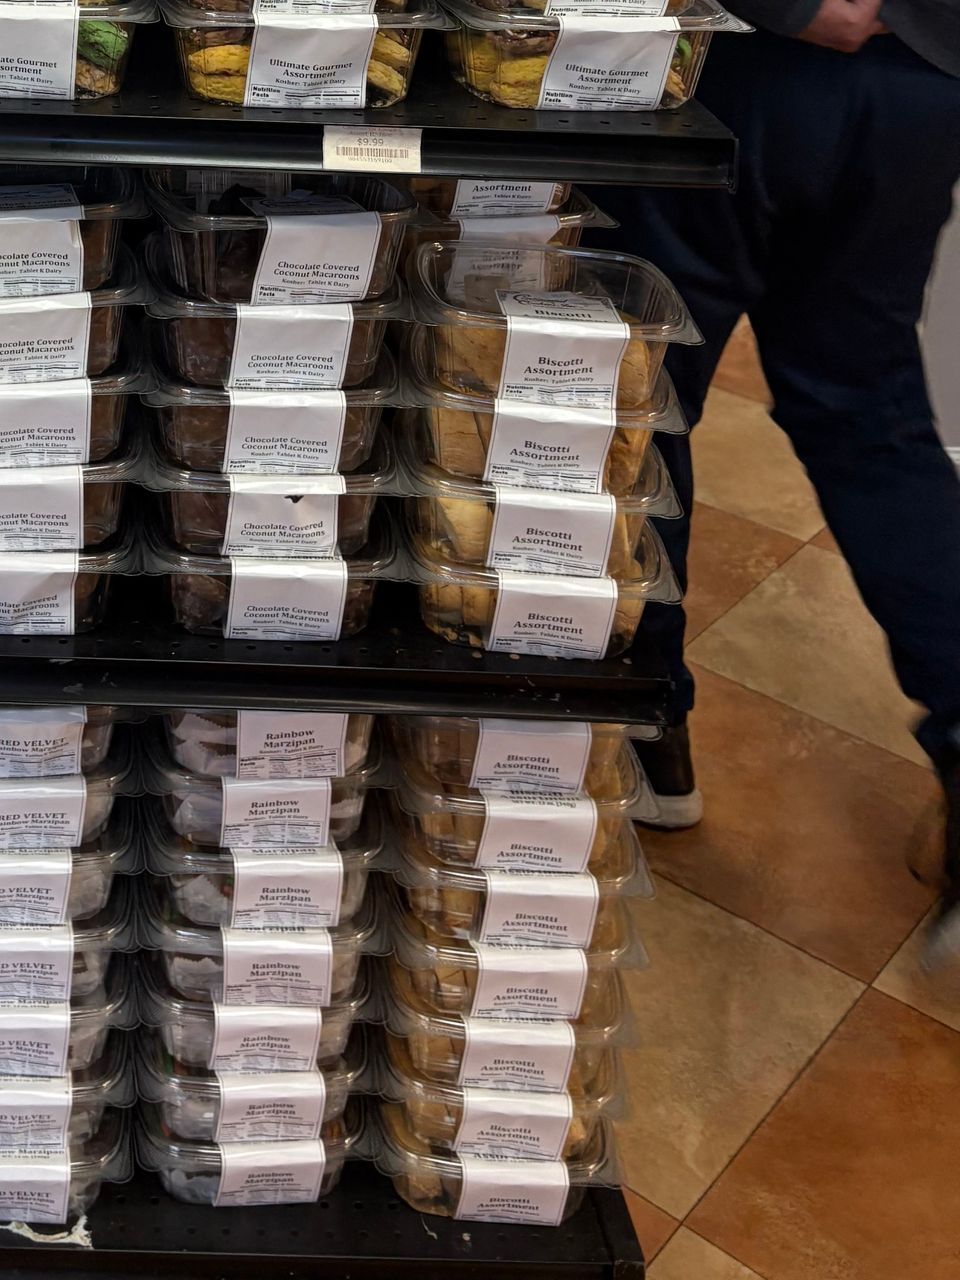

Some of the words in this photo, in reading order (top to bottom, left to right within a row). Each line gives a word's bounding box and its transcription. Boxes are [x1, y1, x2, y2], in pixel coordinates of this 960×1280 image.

[357, 137, 384, 147] $9.99
[278, 262, 320, 270] Chocolate
[323, 264, 359, 272] Covered
[274, 269, 310, 277] Coconut
[312, 271, 359, 280] Macaroons
[286, 361, 334, 370] Macaroons
[538, 357, 583, 366] Biscotti
[524, 365, 592, 376] Assortment
[524, 441, 569, 453] Biscotti
[510, 447, 579, 461] Assortment
[266, 730, 314, 741] Rainbow
[264, 738, 315, 750] Marzipan
[507, 755, 550, 764] Biscotti
[494, 762, 559, 773] Assortment
[251, 800, 298, 810] Rainbow
[249, 806, 300, 817] Marzipan
[31, 817, 70, 825] Marzipan
